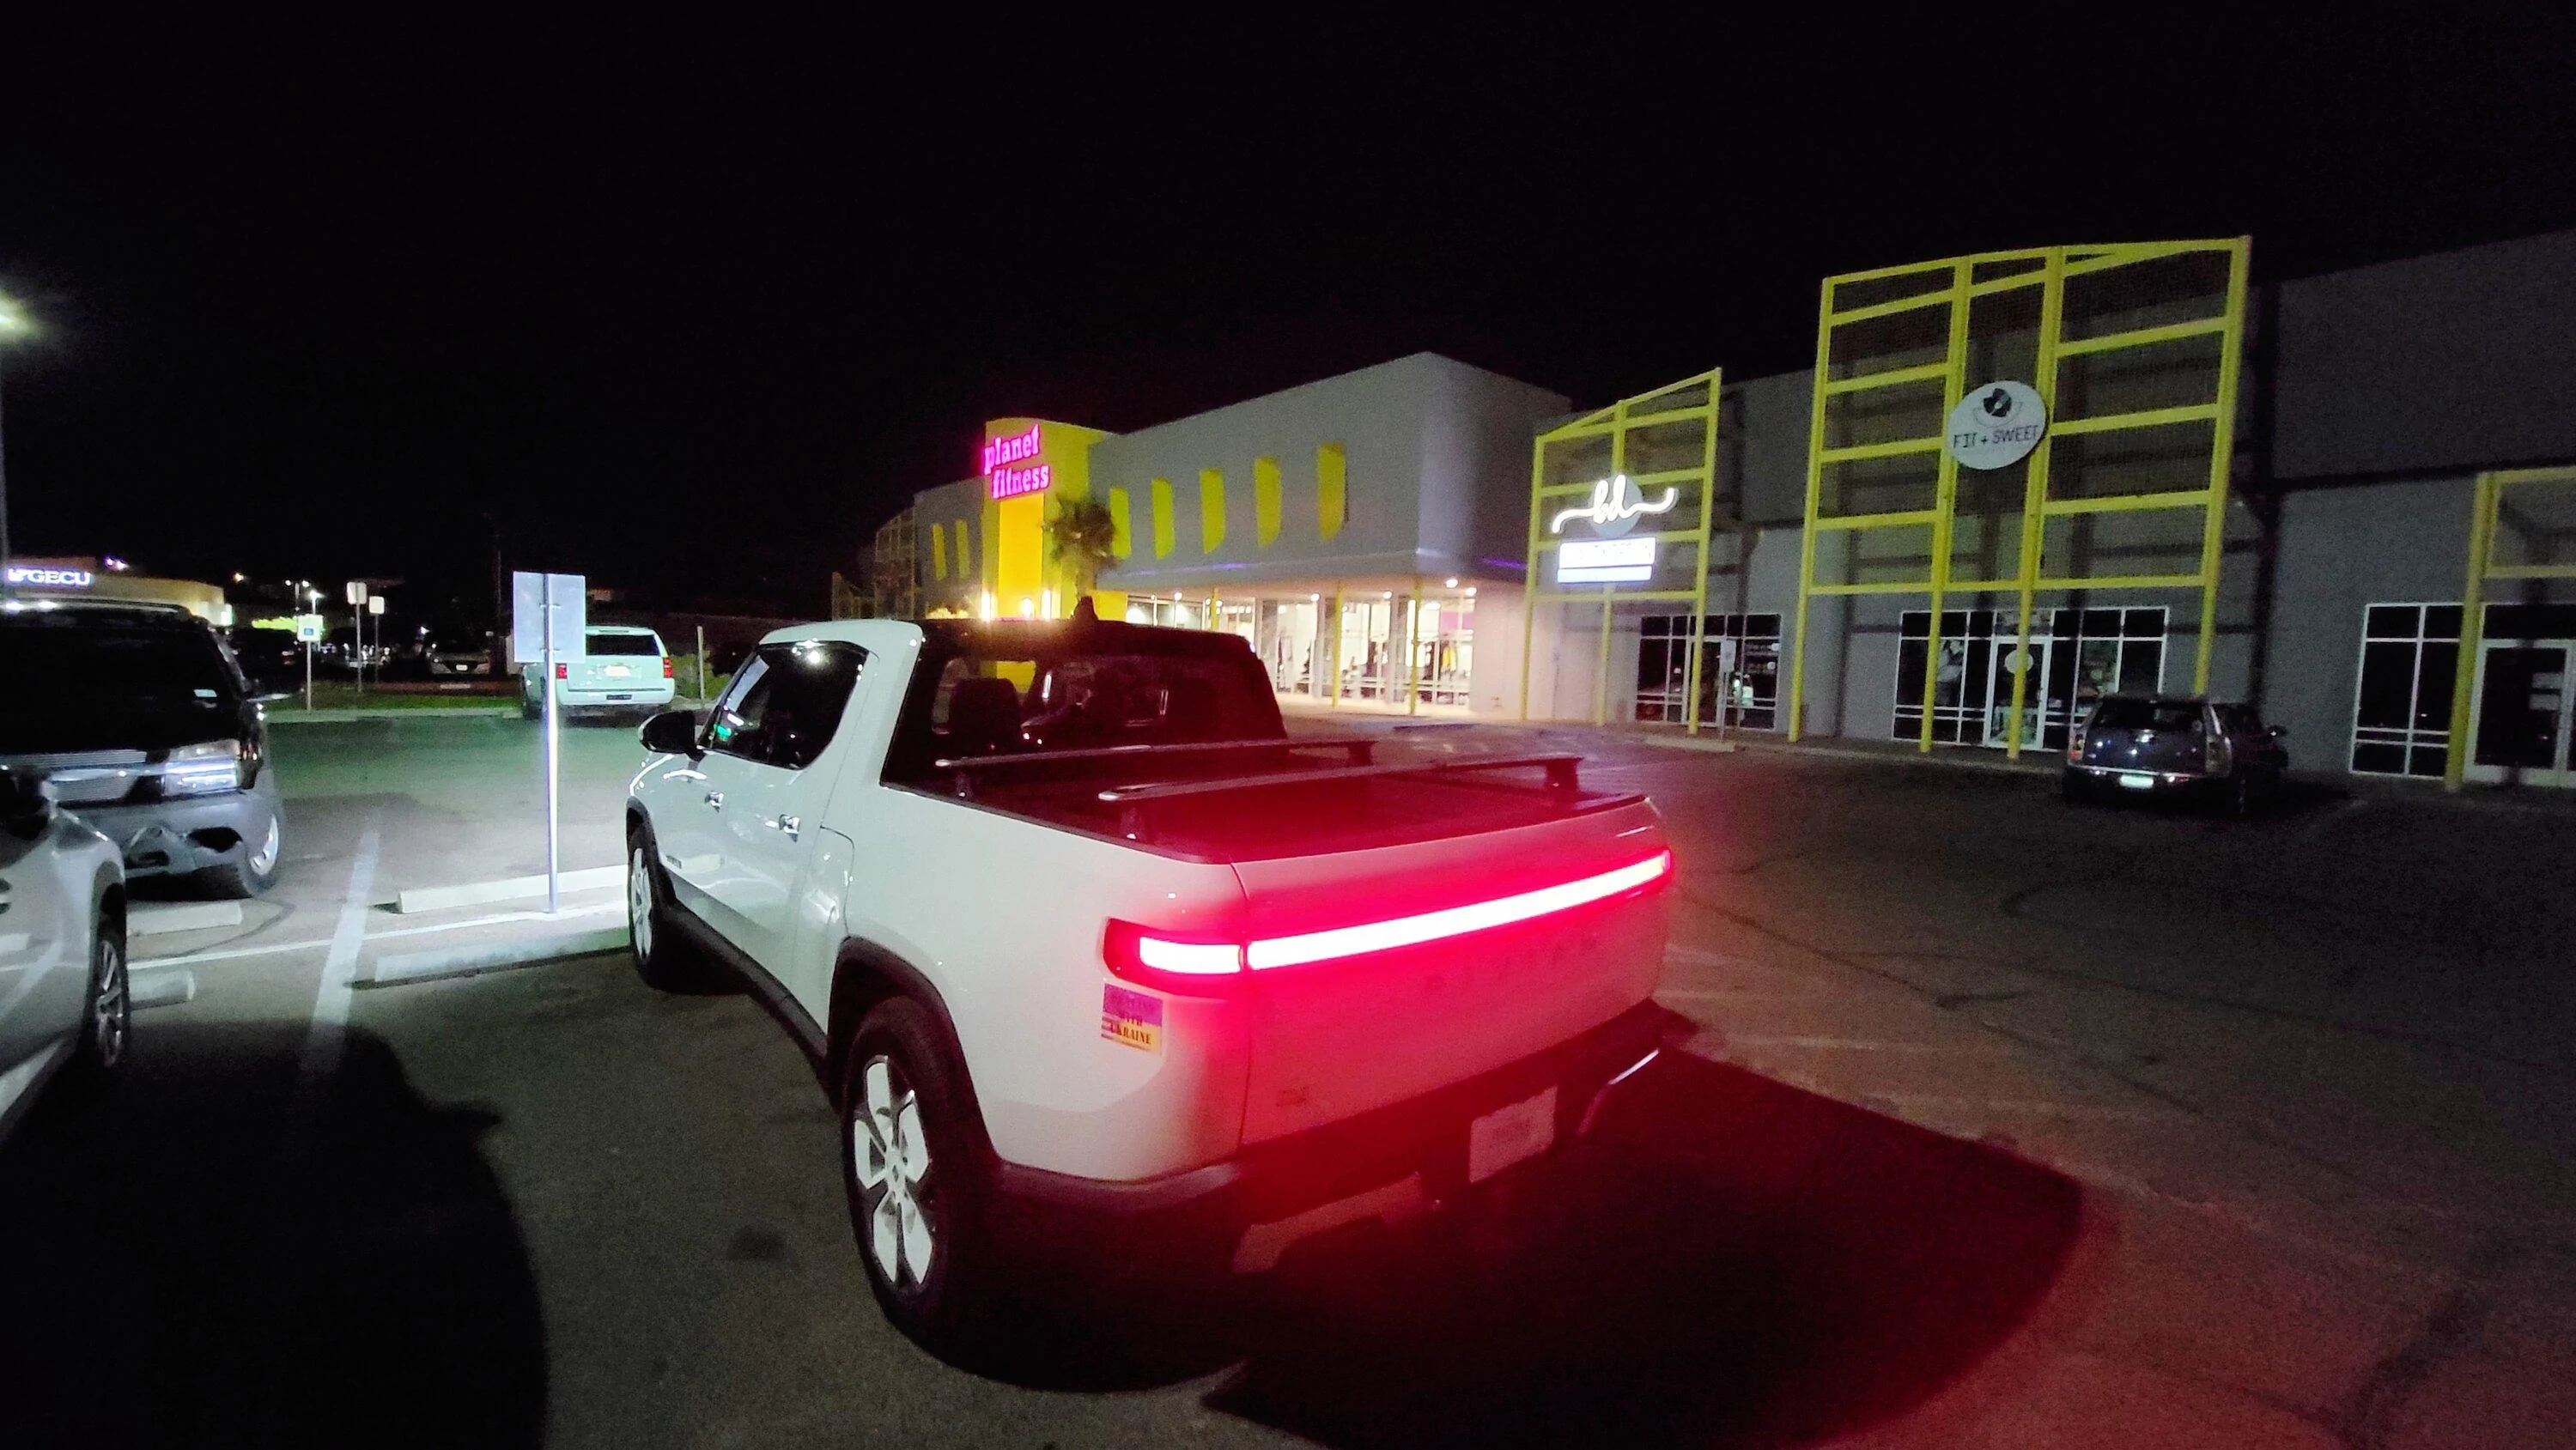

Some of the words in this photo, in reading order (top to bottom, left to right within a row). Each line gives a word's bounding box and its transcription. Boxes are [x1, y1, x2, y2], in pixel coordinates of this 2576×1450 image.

[984, 423, 1040, 476] planet
[1953, 433, 1978, 448] FIT
[1992, 425, 2039, 444] SWEET
[993, 464, 1049, 499] fitness
